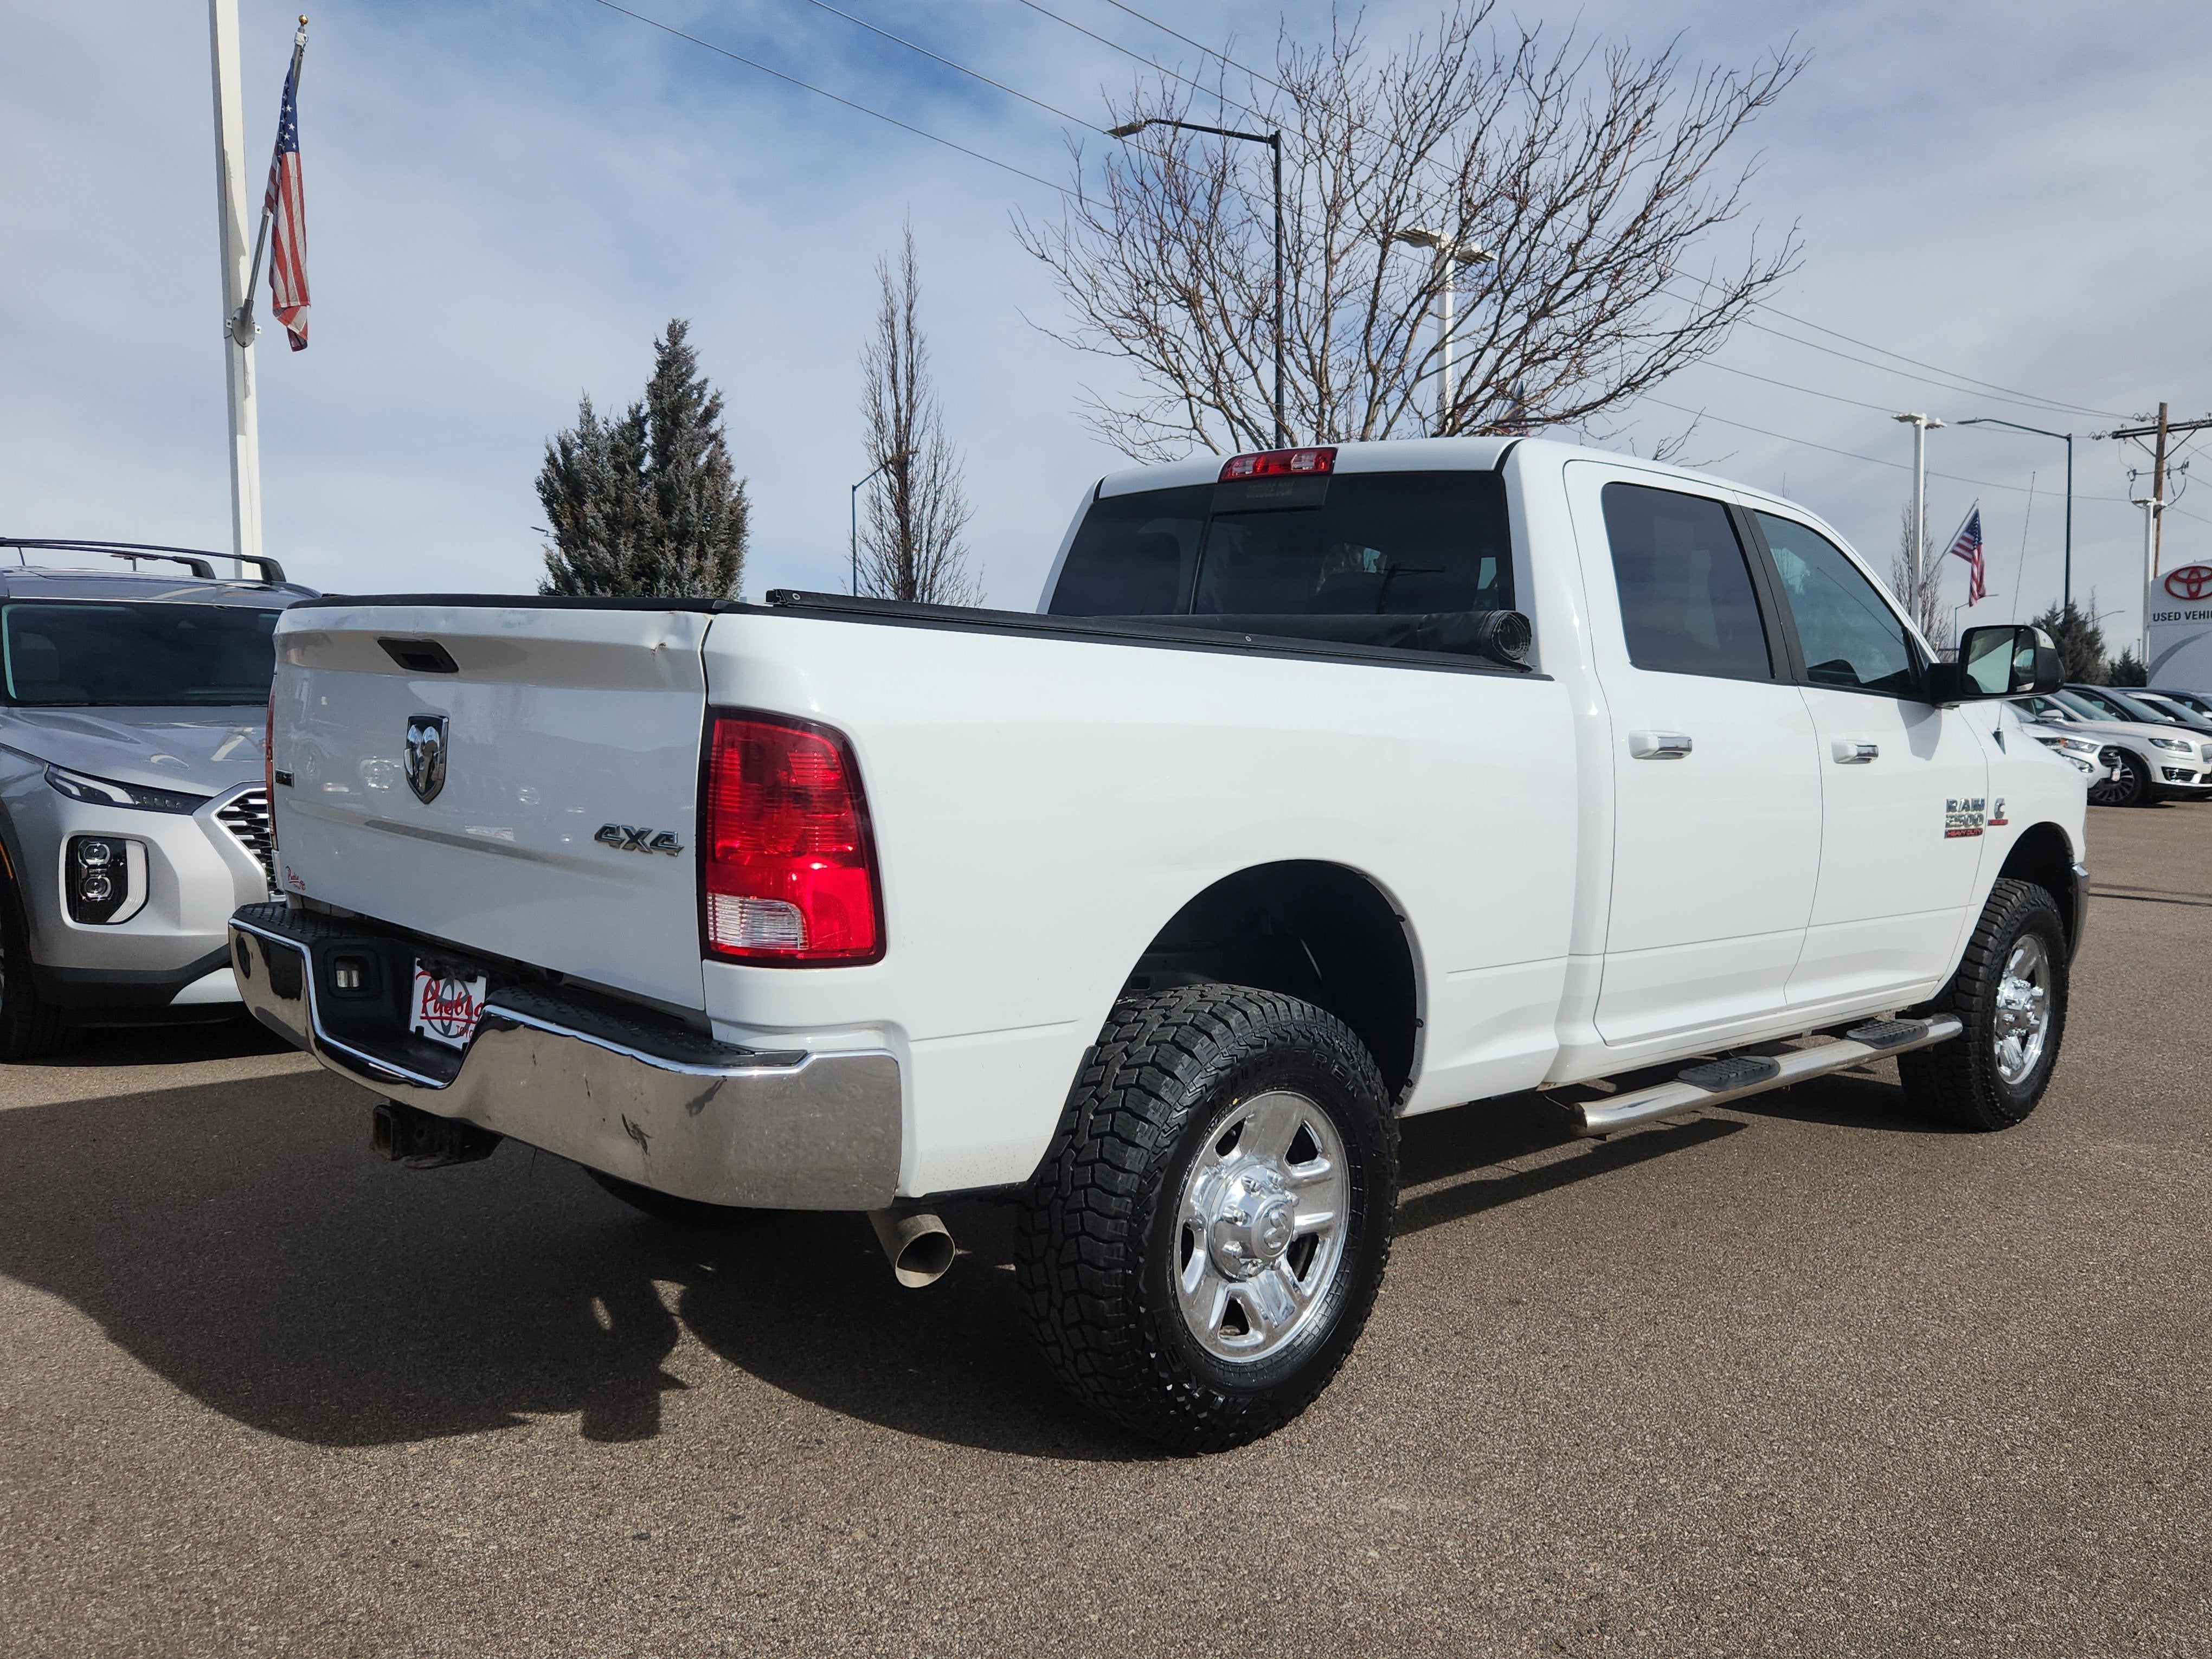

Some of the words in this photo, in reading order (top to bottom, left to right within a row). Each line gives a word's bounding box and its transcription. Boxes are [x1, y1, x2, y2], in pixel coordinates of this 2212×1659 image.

[2153, 612, 2181, 622] USED
[1946, 798, 1985, 812] RAM
[416, 970, 484, 1018] Pueblo
